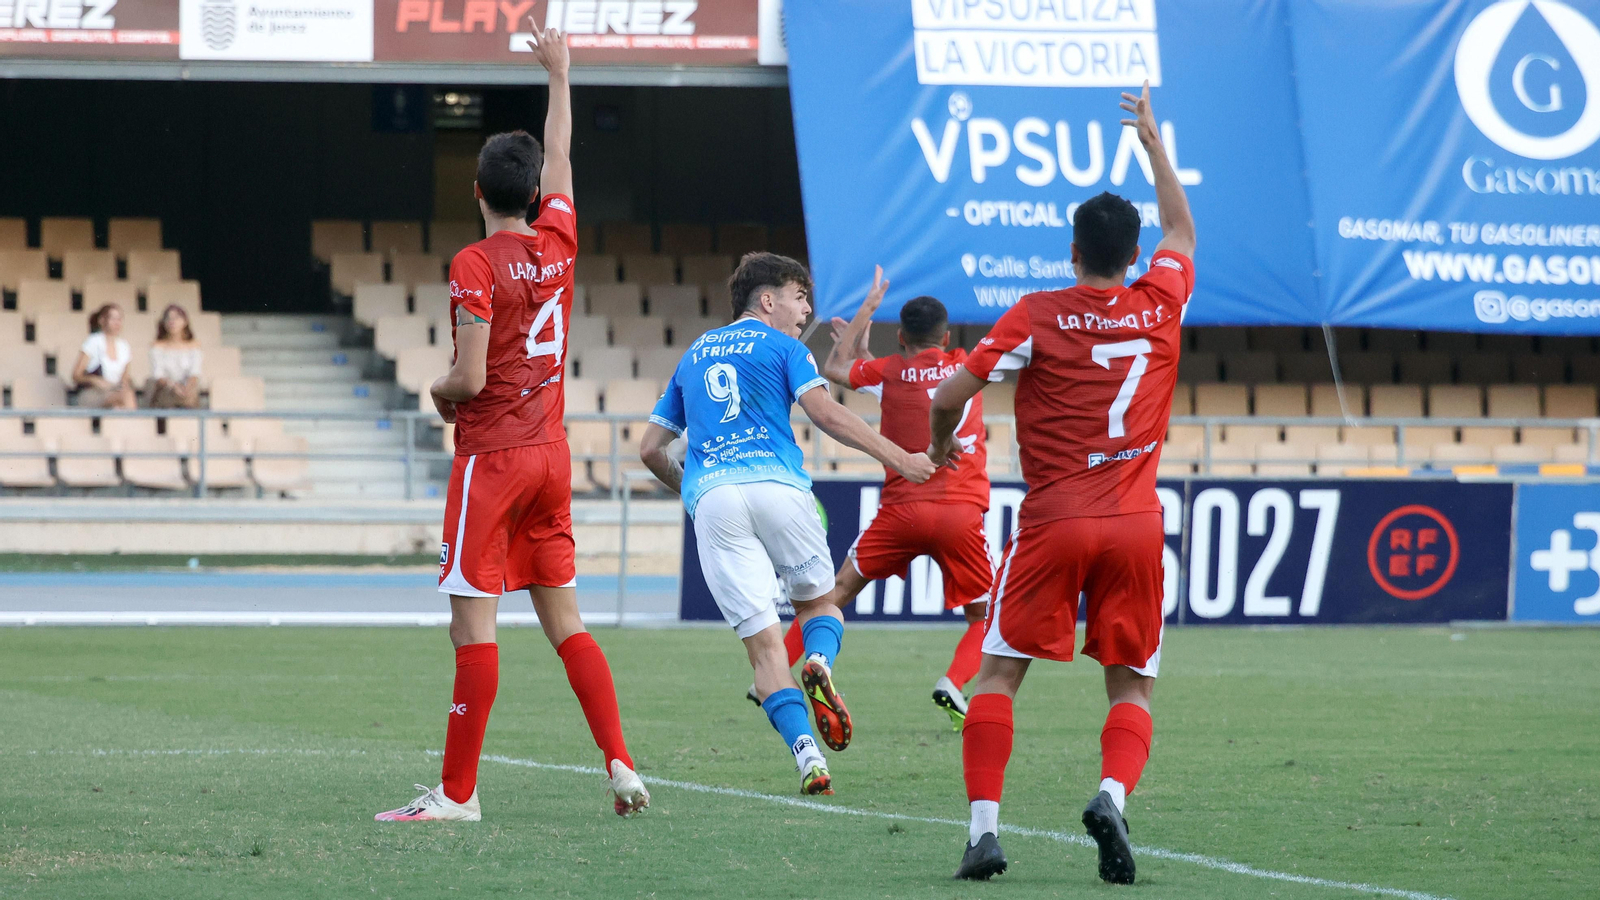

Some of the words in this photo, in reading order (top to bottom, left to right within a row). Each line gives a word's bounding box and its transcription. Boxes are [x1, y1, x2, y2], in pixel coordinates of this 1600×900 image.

[396, 0, 537, 33] PLAY
[927, 0, 1138, 21] VIPSUALIZA
[922, 40, 967, 73] LA
[975, 41, 1150, 76] VICTORIA
[963, 200, 1064, 227] OPTICAL
[1338, 215, 1445, 246] GASOMAR,
[1448, 222, 1479, 244] TU
[1480, 222, 1600, 247] GASOLINER
[978, 254, 1029, 279] Calle
[525, 286, 566, 368] 4
[1056, 314, 1081, 330] LA
[901, 367, 918, 382] LA
[1091, 338, 1152, 439] 7
[703, 361, 742, 424] 9
[697, 468, 728, 487] XEREZ
[729, 463, 787, 476] DEPORTIVO
